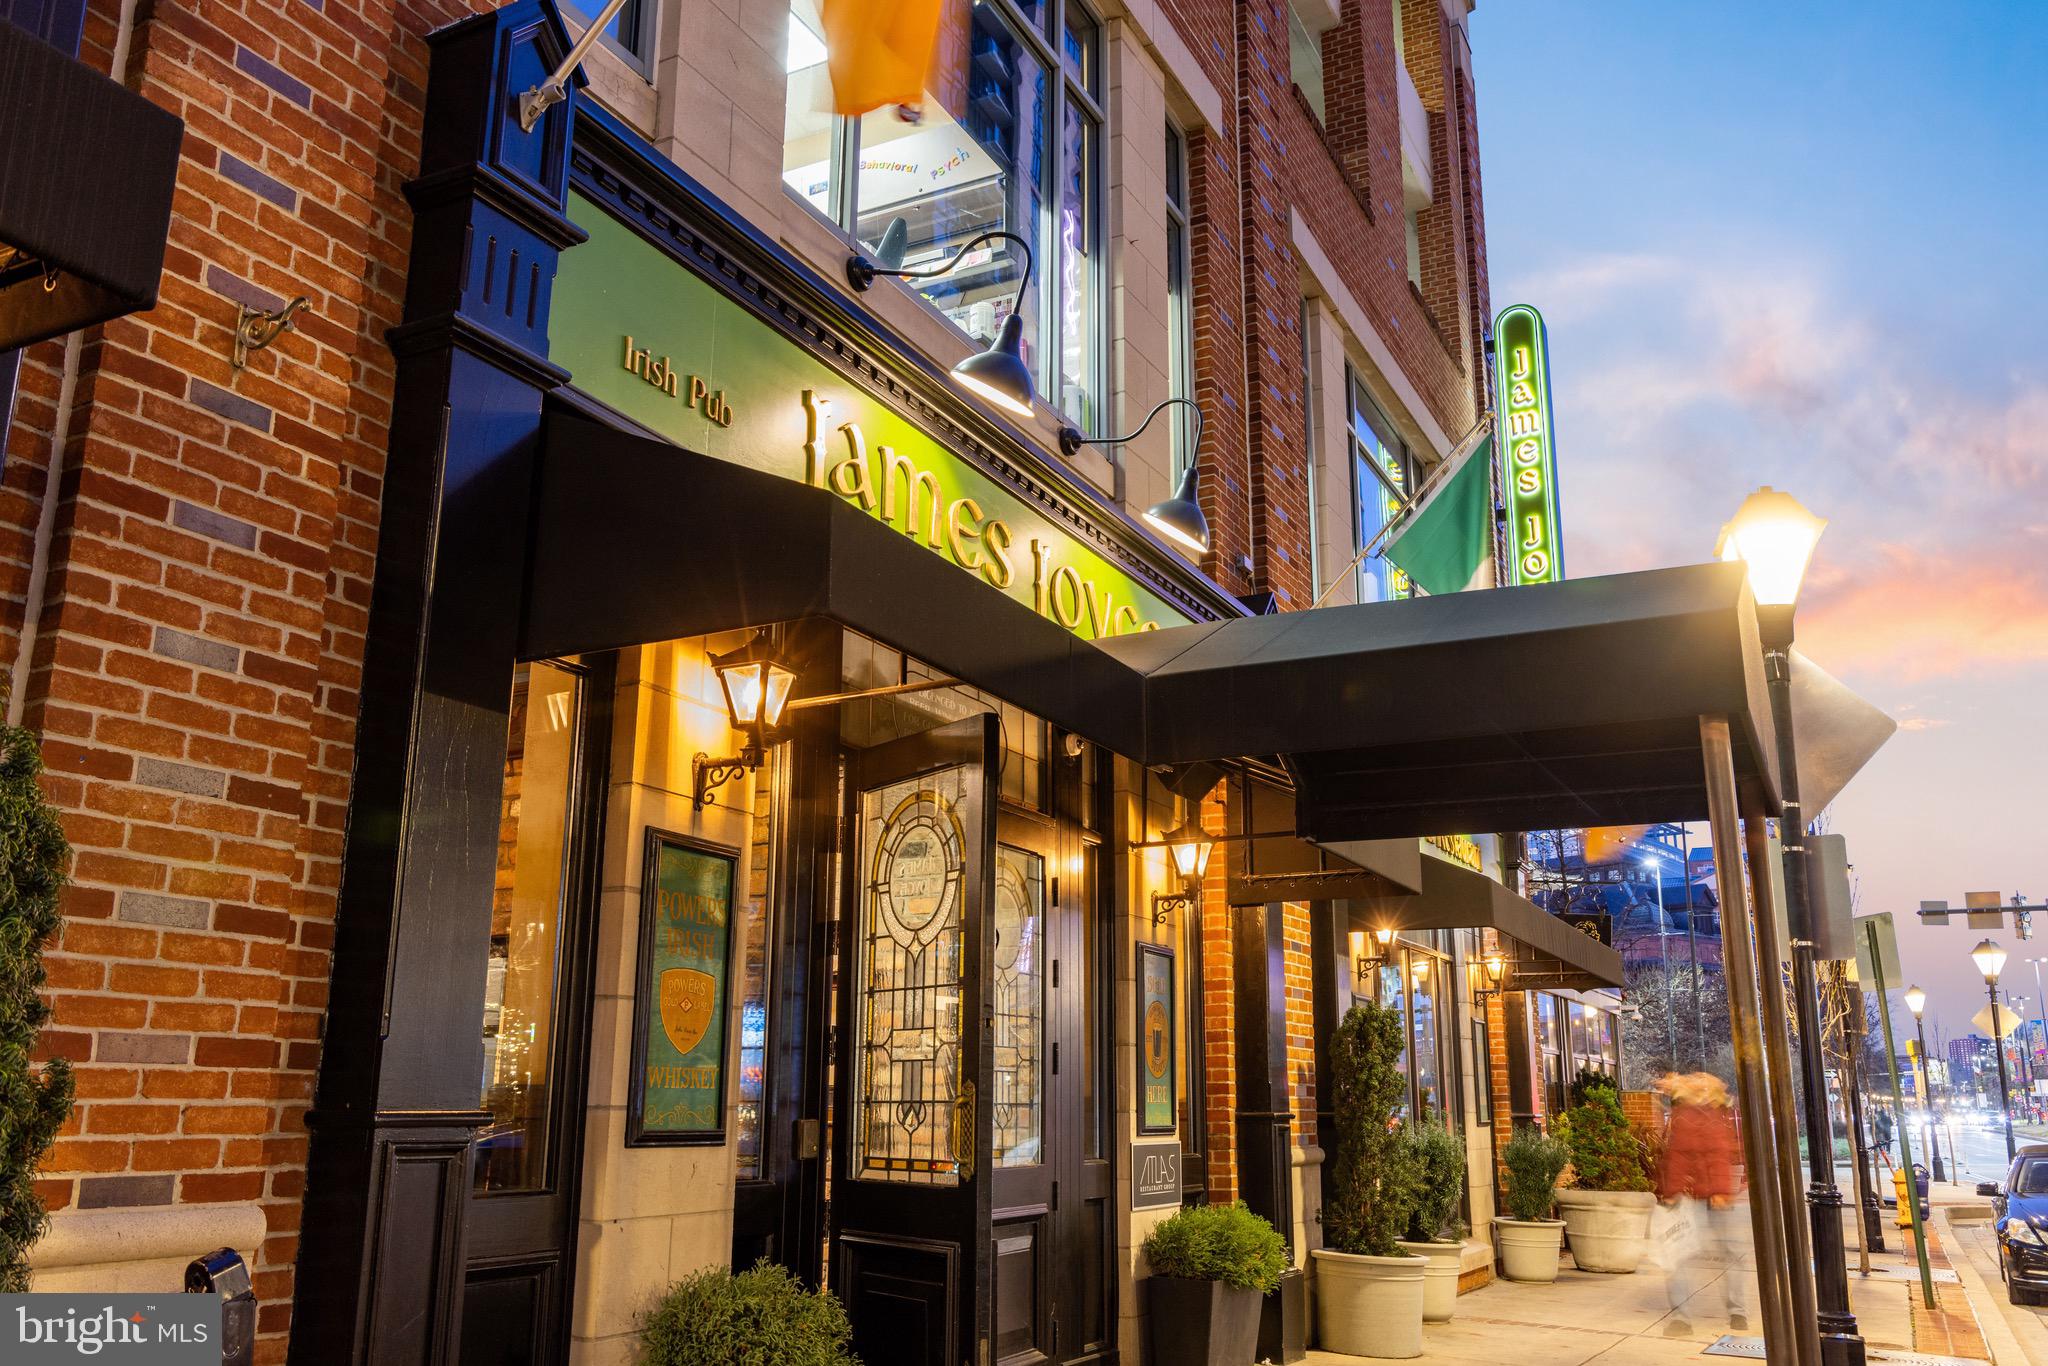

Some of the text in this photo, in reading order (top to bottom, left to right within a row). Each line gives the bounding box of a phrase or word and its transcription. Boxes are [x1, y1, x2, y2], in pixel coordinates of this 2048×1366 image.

[624, 335, 734, 428] Irish Pub
[801, 389, 1015, 589] James
[1523, 514, 1550, 584] Jo
[656, 889, 727, 929] POWERS
[666, 927, 716, 961] IRISH
[668, 978, 707, 996] POWERS
[646, 1063, 719, 1089] WHISKEY
[1140, 1154, 1176, 1185] ATLAS
